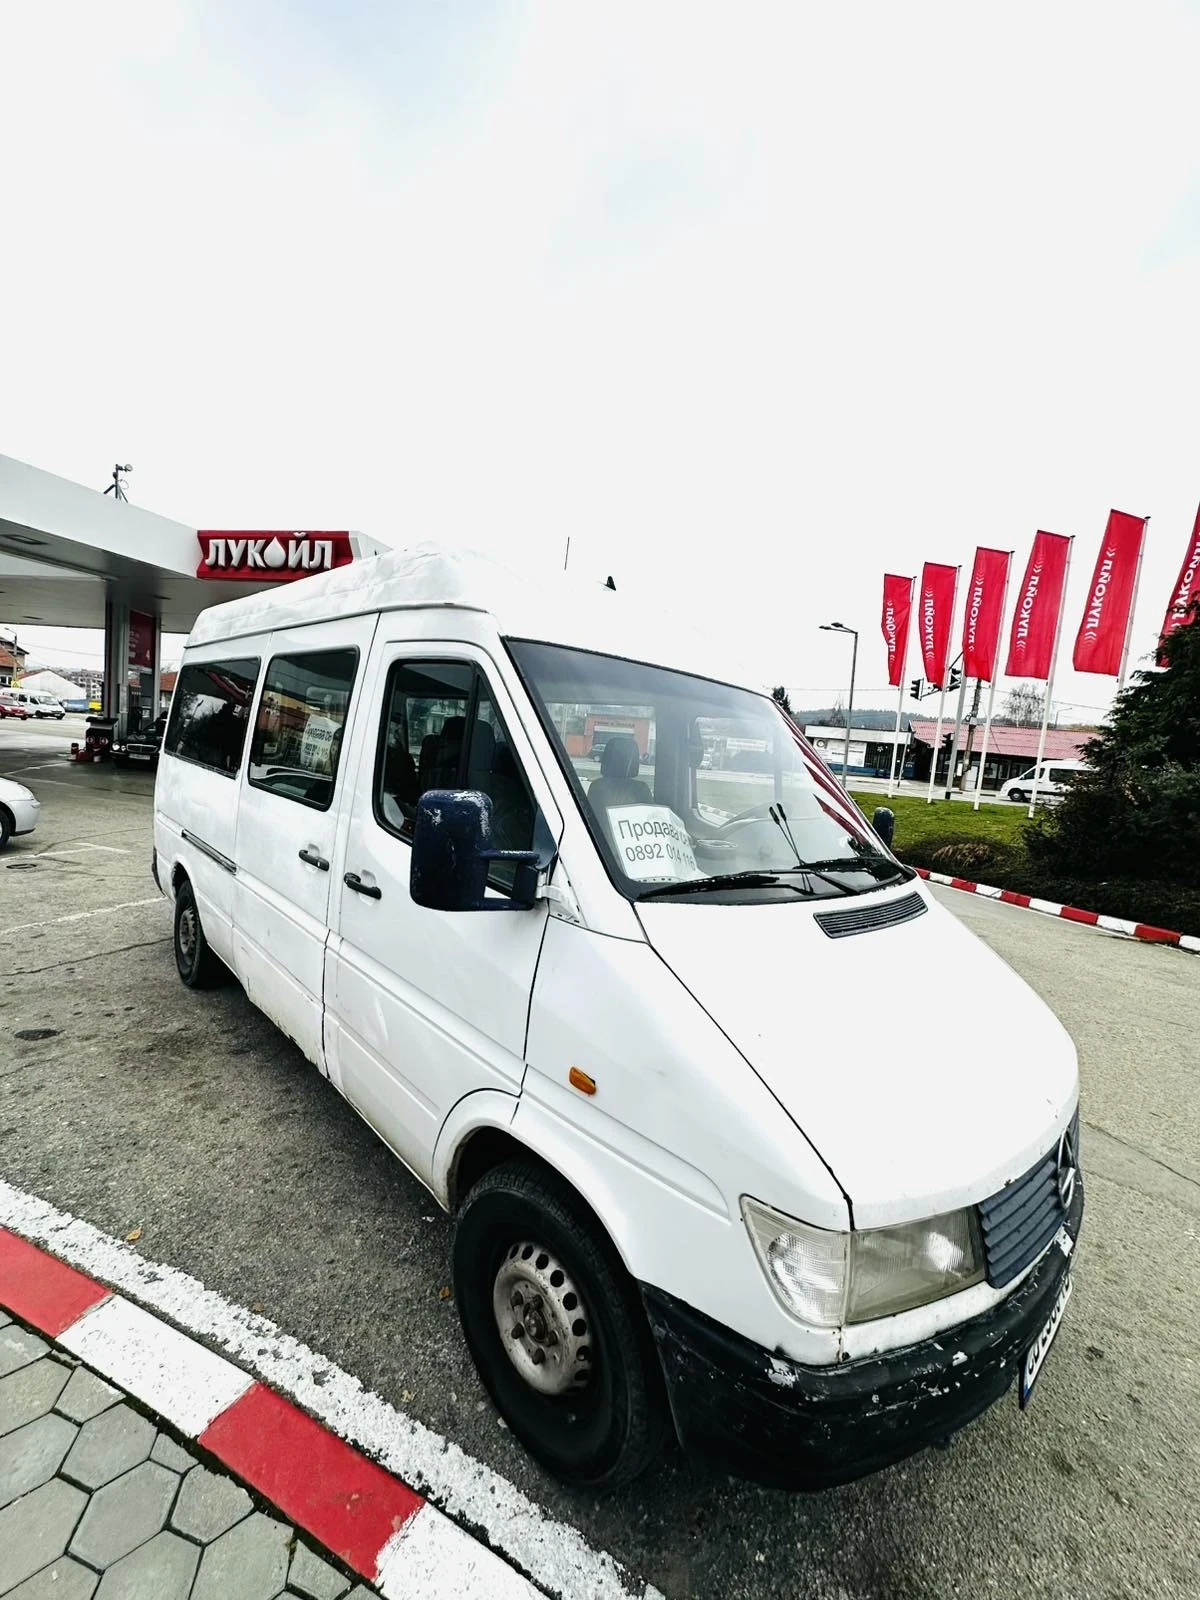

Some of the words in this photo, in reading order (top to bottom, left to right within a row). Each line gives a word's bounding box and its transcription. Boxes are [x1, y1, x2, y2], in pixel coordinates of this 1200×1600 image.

[618, 820, 679, 841] Продава
[625, 843, 664, 862] 0892
[666, 843, 681, 863] 014
